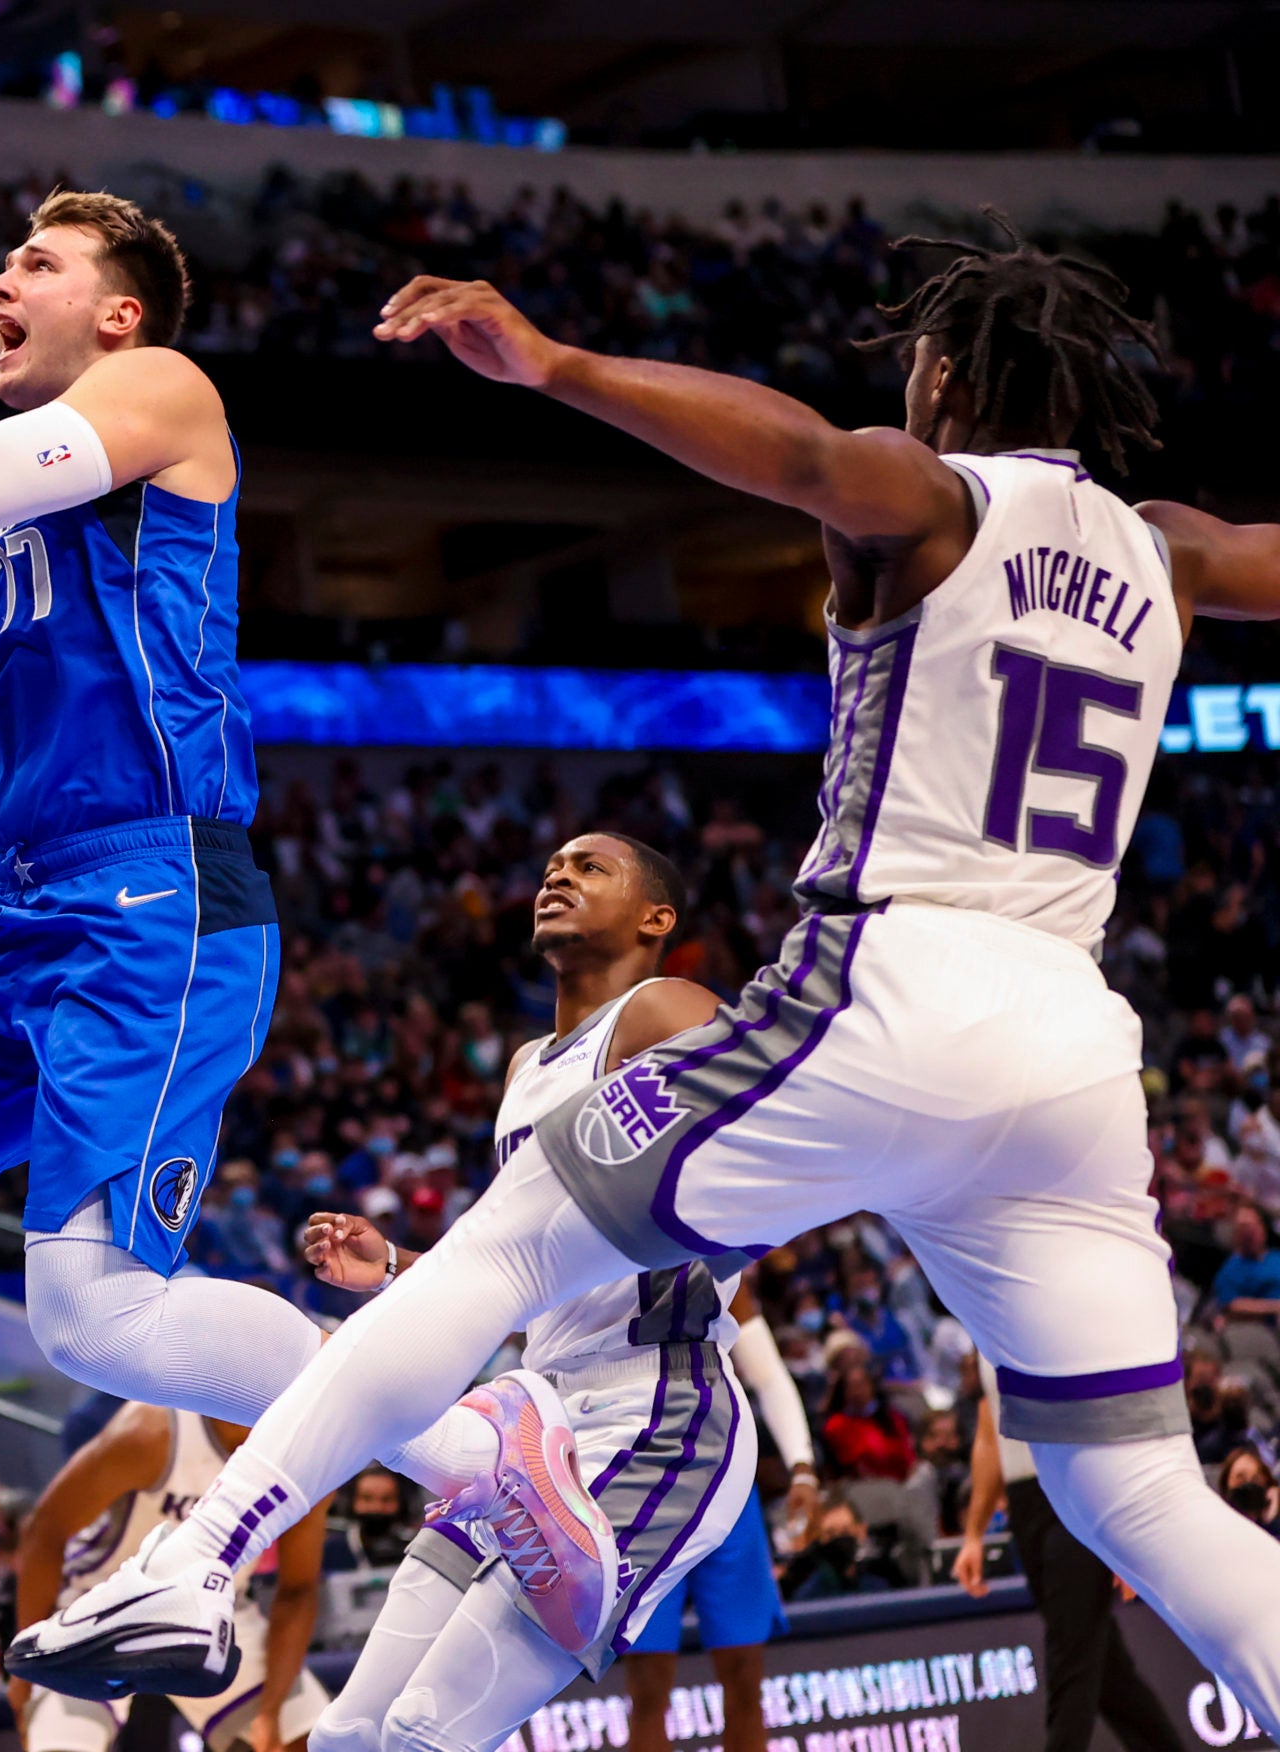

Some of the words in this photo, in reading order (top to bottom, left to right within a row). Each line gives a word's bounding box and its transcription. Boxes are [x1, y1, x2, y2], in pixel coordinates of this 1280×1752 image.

[1003, 546, 1153, 654] MITCHELL
[982, 640, 1144, 870] 15
[600, 1079, 656, 1151] SAC
[203, 1572, 231, 1593] GT
[528, 1682, 725, 1752] RESPOIBLY
